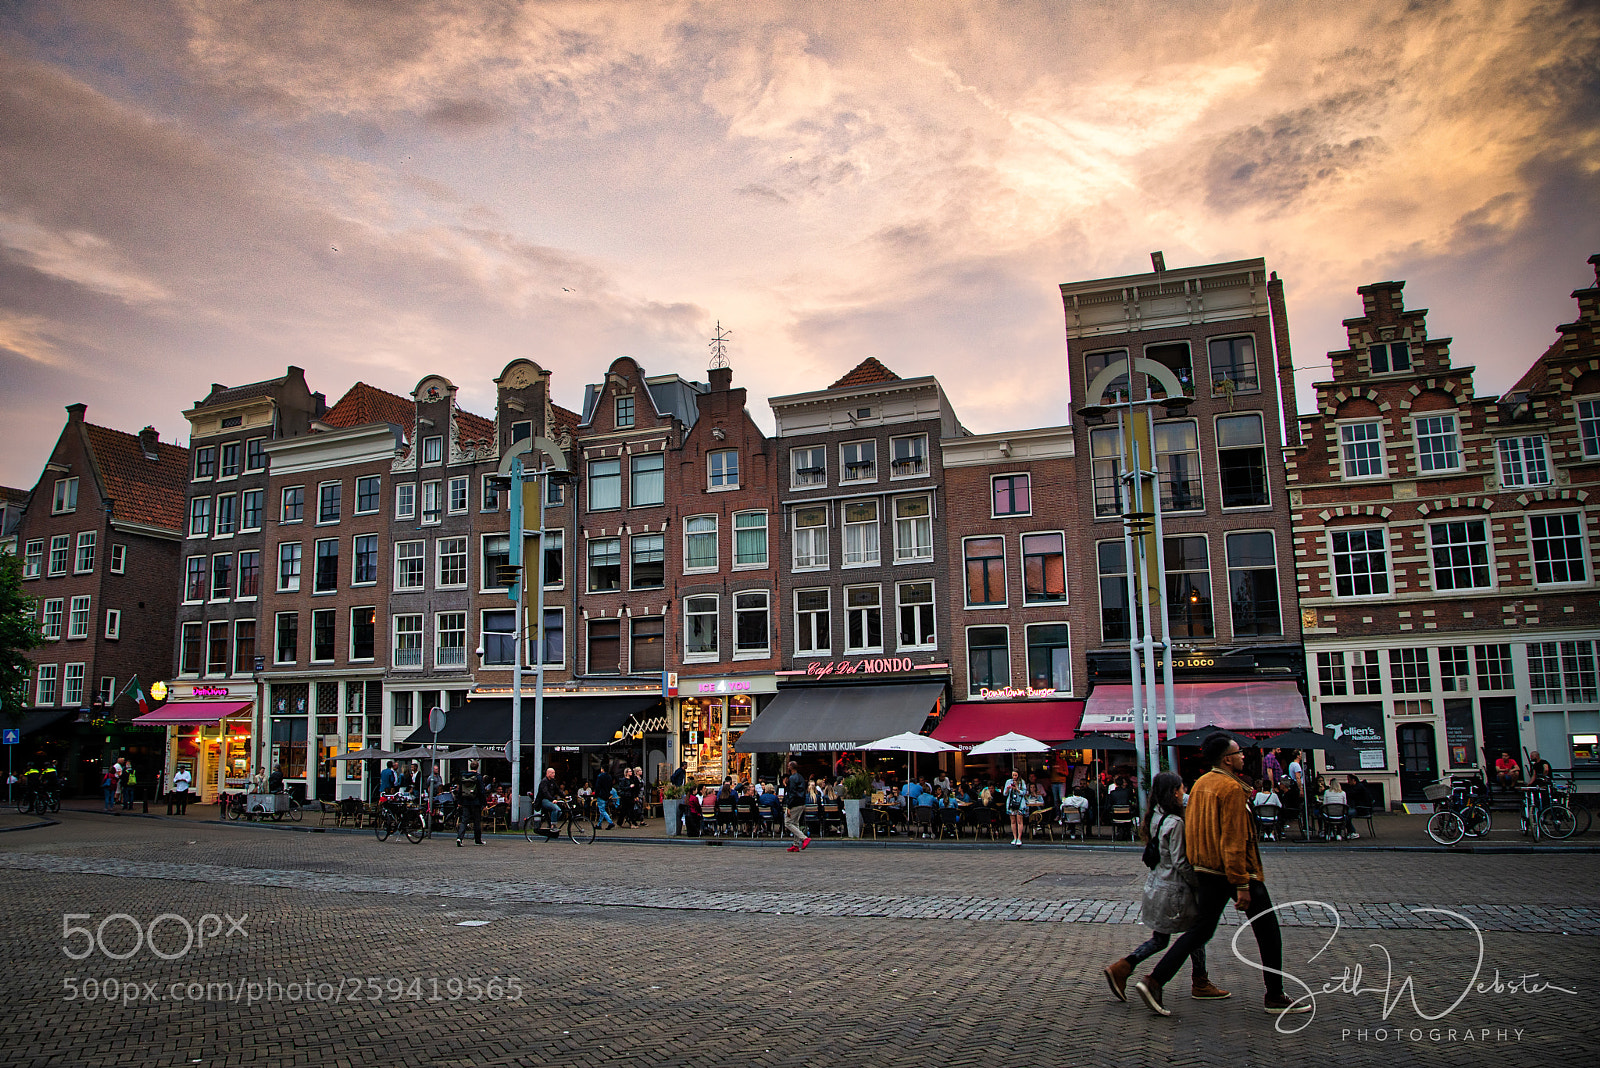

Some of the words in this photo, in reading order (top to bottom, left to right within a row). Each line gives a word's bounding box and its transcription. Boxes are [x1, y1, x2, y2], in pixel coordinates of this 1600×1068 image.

[835, 660, 863, 675] Del
[864, 658, 913, 673] MONDO
[1157, 660, 1185, 668] PCO
[1187, 658, 1215, 667] LOCO
[698, 683, 716, 692] ICE
[717, 679, 727, 693] 4
[728, 681, 751, 691] YOU
[1026, 686, 1057, 698] Burger
[789, 743, 818, 752] MIDDEN
[818, 743, 827, 751] IN
[828, 742, 857, 751] MOKUM
